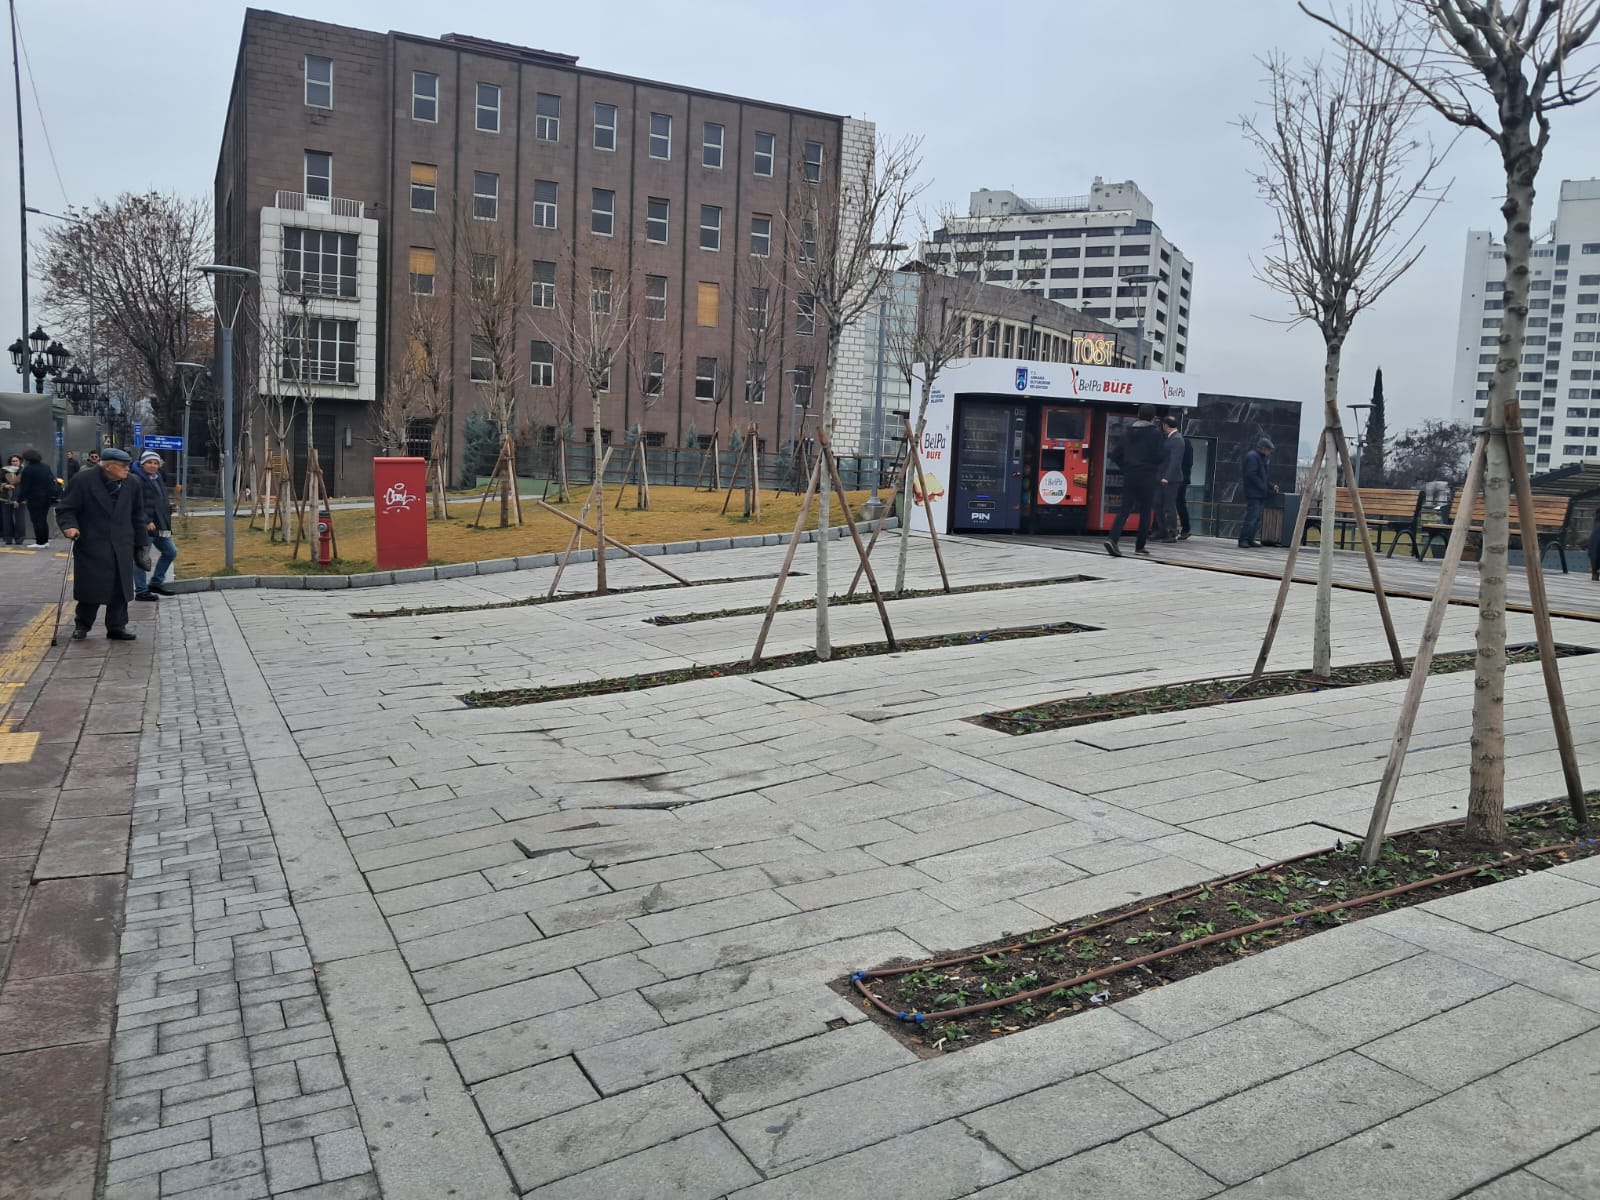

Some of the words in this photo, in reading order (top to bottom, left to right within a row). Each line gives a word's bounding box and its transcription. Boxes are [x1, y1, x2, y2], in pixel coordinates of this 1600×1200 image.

[1072, 337, 1115, 365] TOST
[1078, 379, 1101, 392] BelPa
[1103, 379, 1133, 394] BÜFE
[1168, 387, 1186, 397] BelPa
[924, 433, 946, 449] BelPa
[971, 512, 991, 521] PIN
